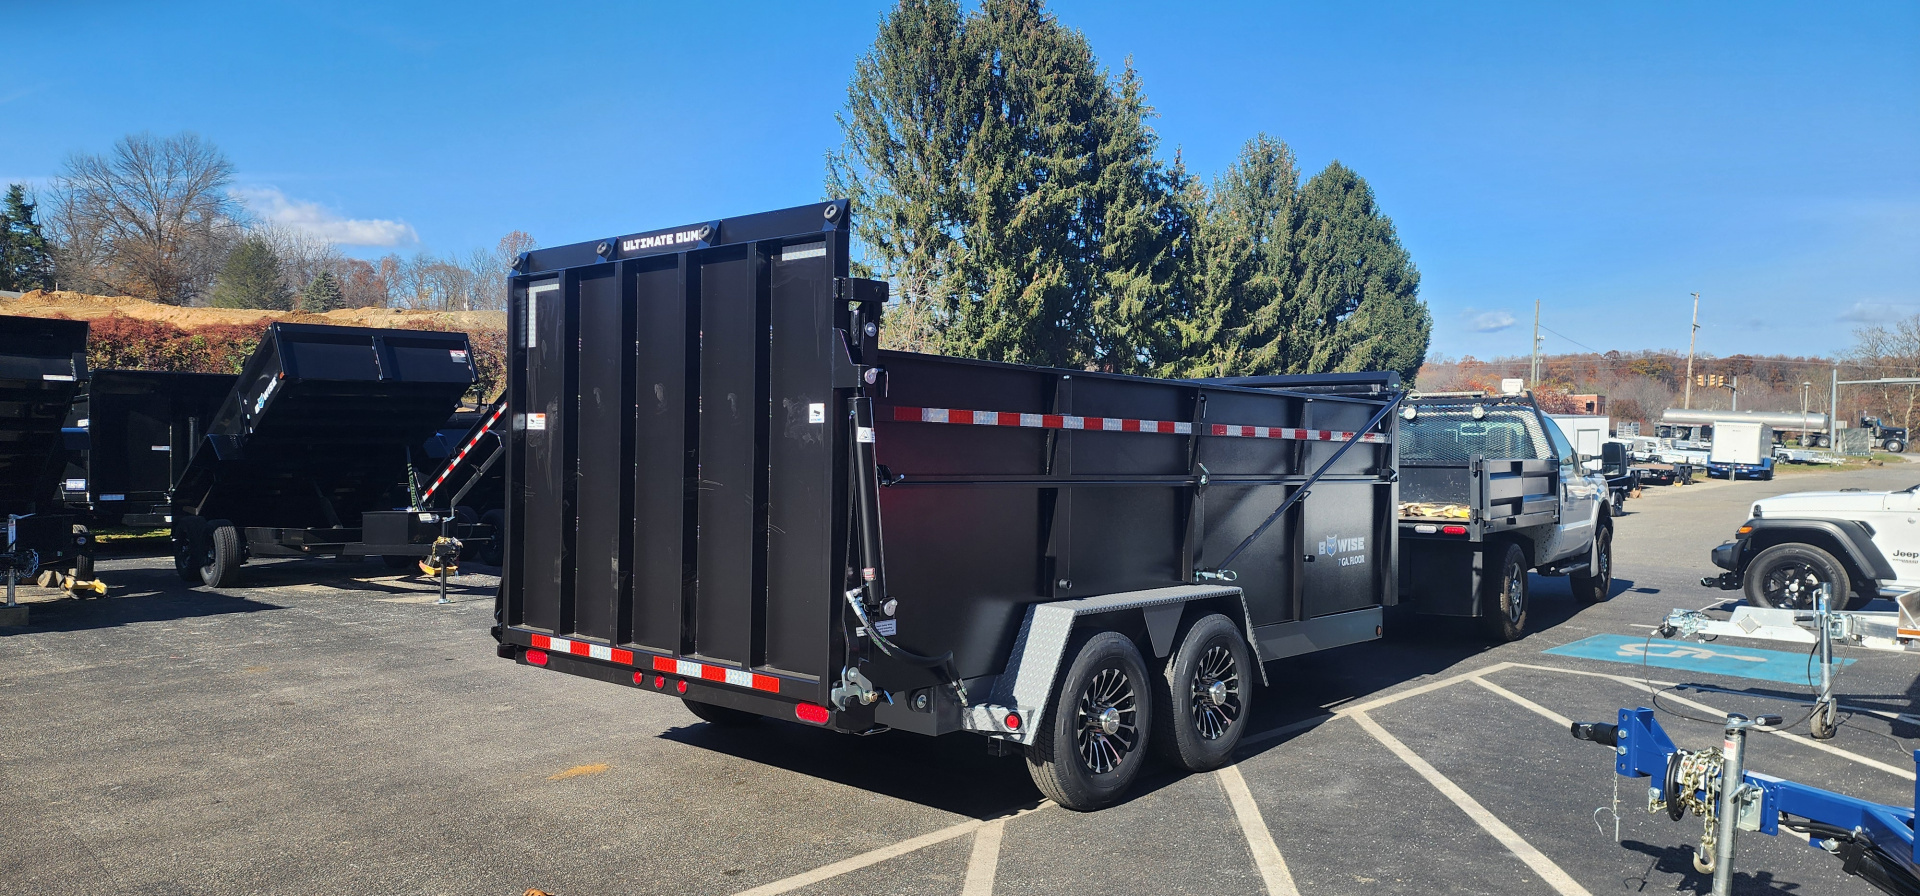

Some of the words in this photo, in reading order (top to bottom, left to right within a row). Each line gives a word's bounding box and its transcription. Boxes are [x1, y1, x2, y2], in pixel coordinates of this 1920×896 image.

[623, 233, 674, 251] ULTIMATE
[677, 229, 702, 243] DUM
[1893, 550, 1919, 559] Jeep
[1349, 555, 1365, 565] FLOOR
